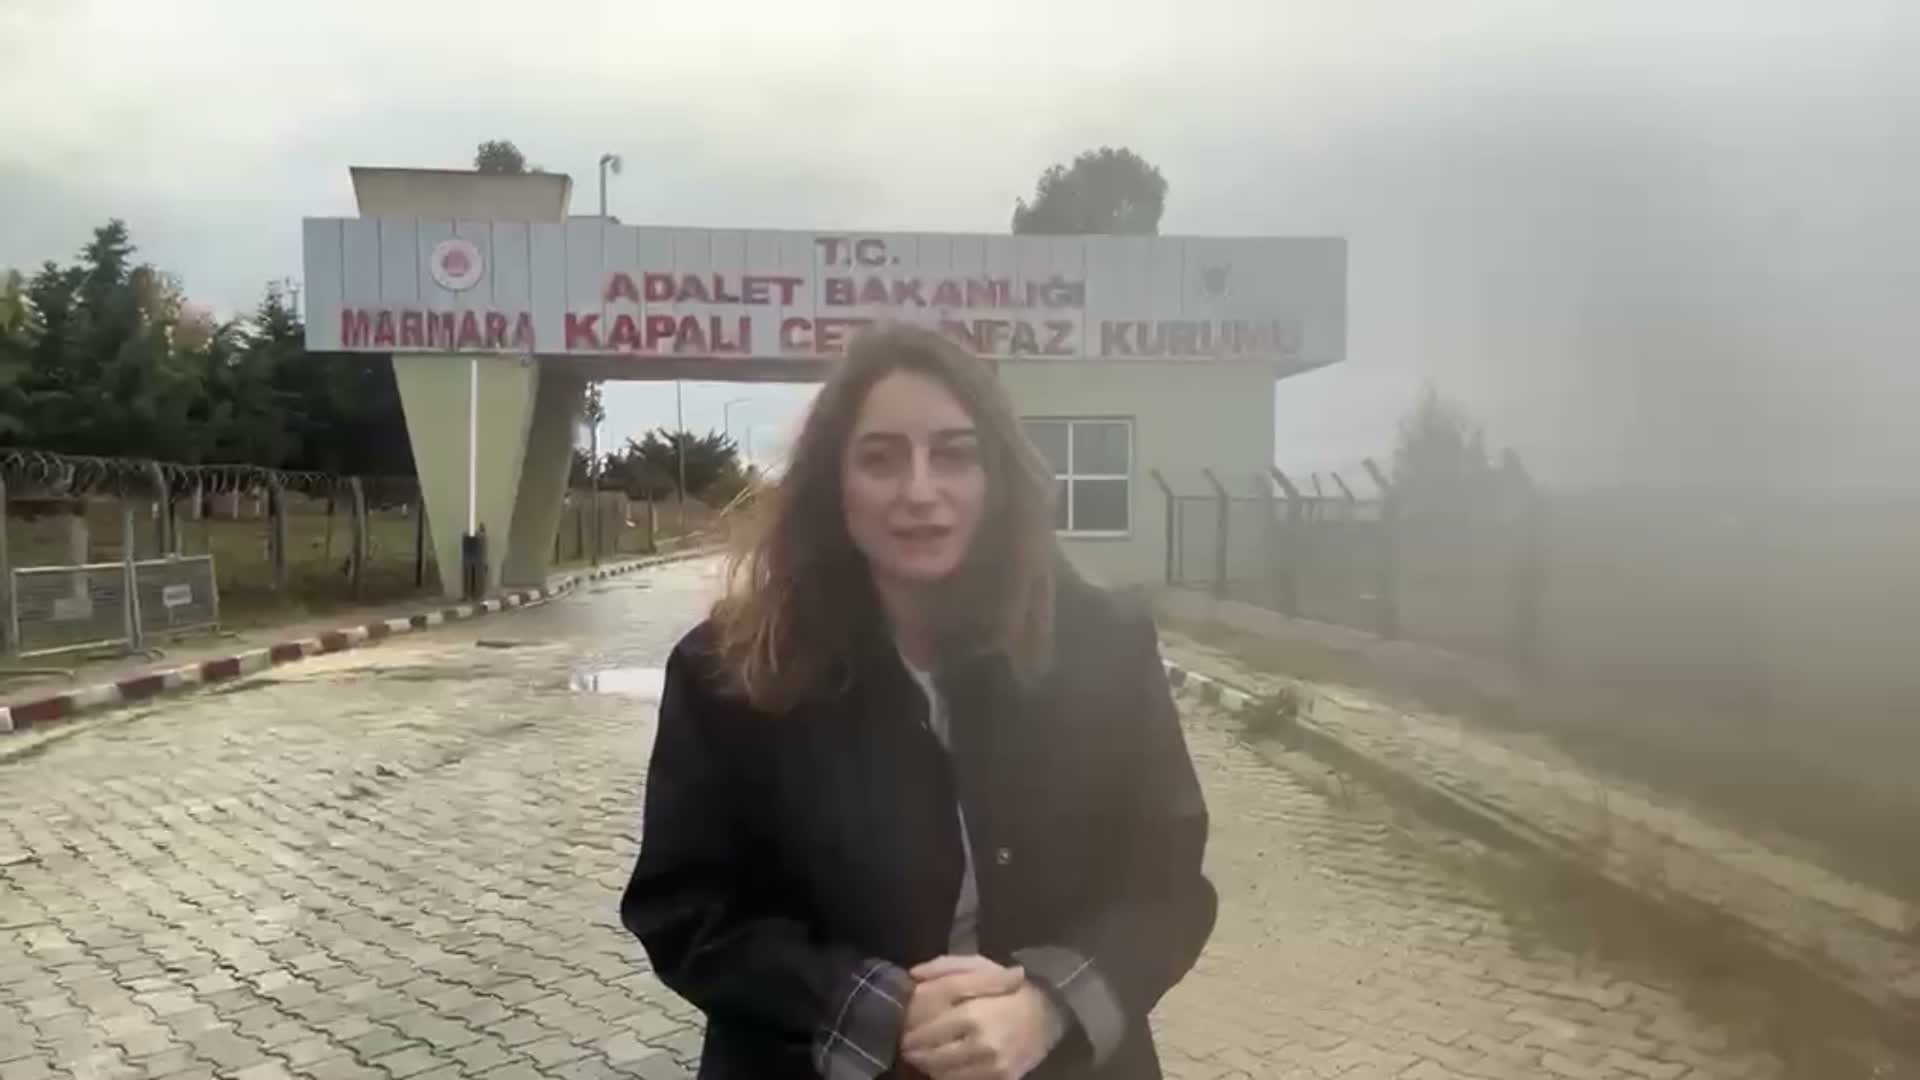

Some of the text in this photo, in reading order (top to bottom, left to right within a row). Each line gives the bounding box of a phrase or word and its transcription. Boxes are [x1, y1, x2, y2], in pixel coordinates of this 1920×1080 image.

[816, 237, 899, 266] T.C.
[607, 272, 1086, 308] ADALET BAKANLIĞI
[341, 309, 536, 352] MARMARA
[565, 313, 752, 355] KAPALI
[780, 317, 877, 354] CE
[1100, 320, 1300, 357] KURUMU
